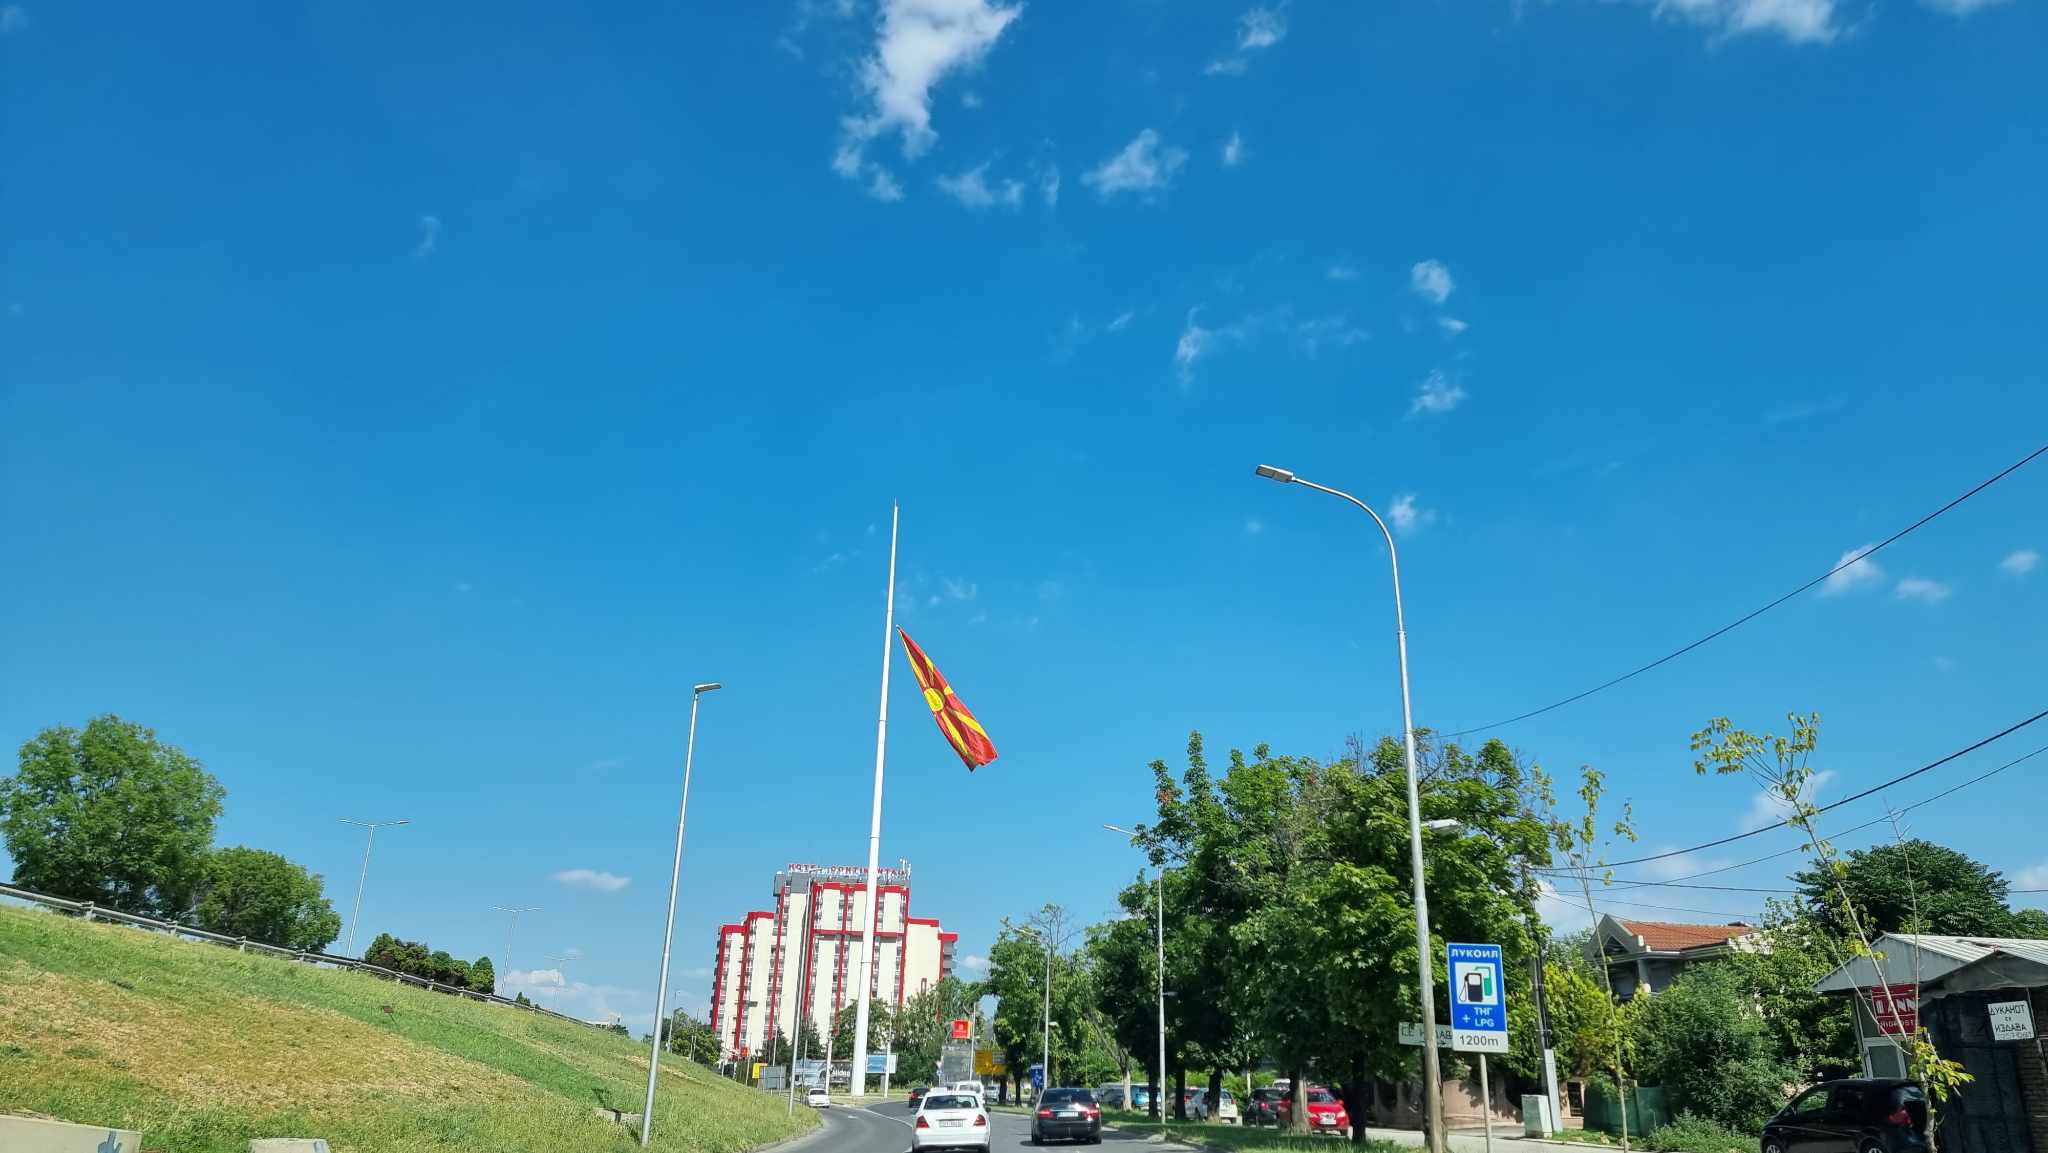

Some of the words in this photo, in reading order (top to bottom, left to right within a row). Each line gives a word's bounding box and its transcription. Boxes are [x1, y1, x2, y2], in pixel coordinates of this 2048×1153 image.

[1451, 948, 1498, 958] ЛУКОИЛ
[1474, 1007, 1493, 1015] ТНГ
[1475, 1018, 1495, 1028] LPG
[1995, 1023, 2028, 1033] ИЗДАВА
[1460, 1034, 1499, 1047] 1200m
